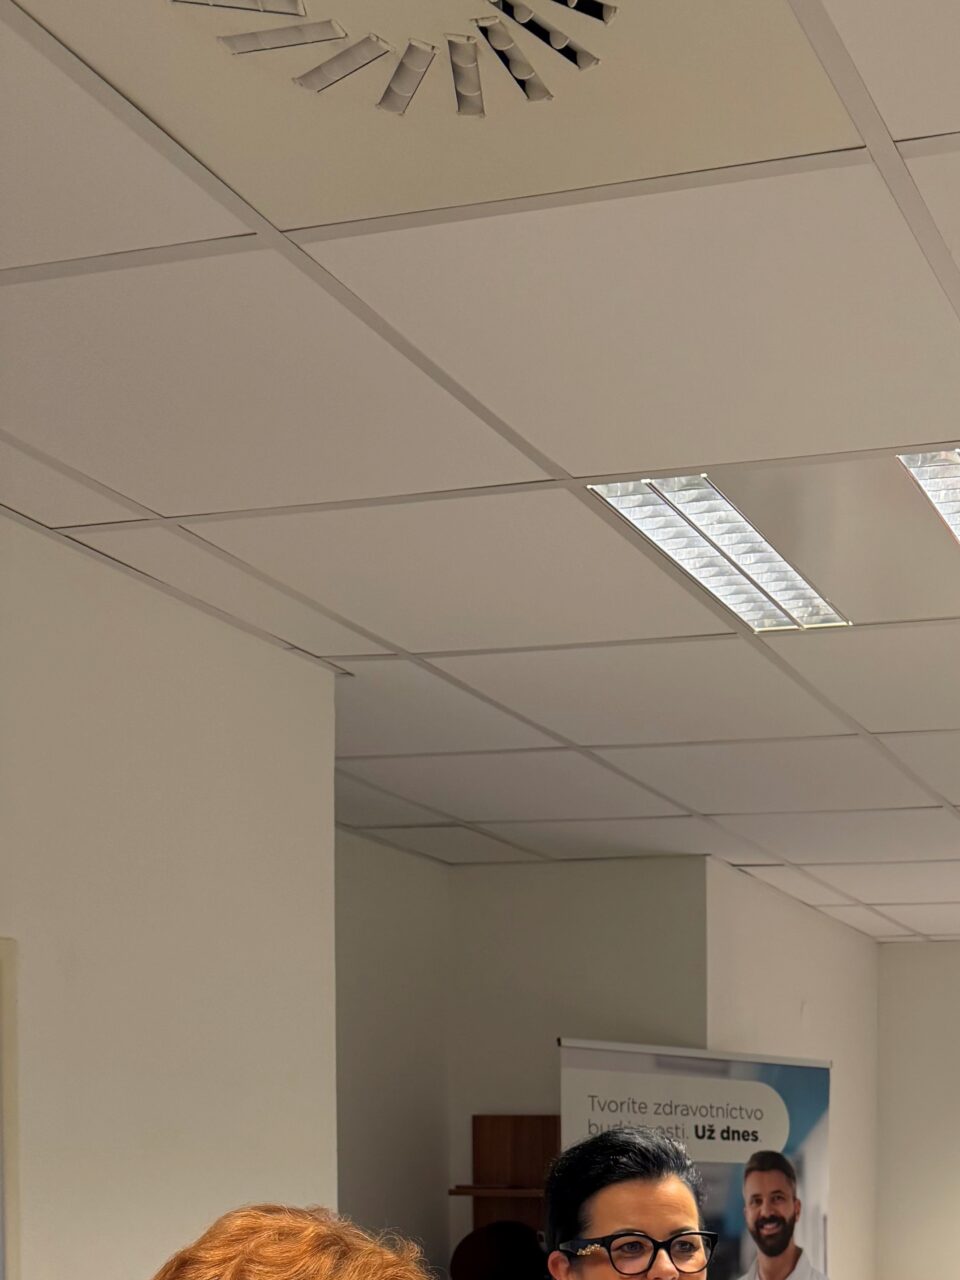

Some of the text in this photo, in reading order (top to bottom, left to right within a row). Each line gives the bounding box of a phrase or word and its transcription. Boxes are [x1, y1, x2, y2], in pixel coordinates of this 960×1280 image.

[587, 1095, 764, 1121] Tvoríte zdravotníctvo
[694, 1124, 716, 1141] Už
